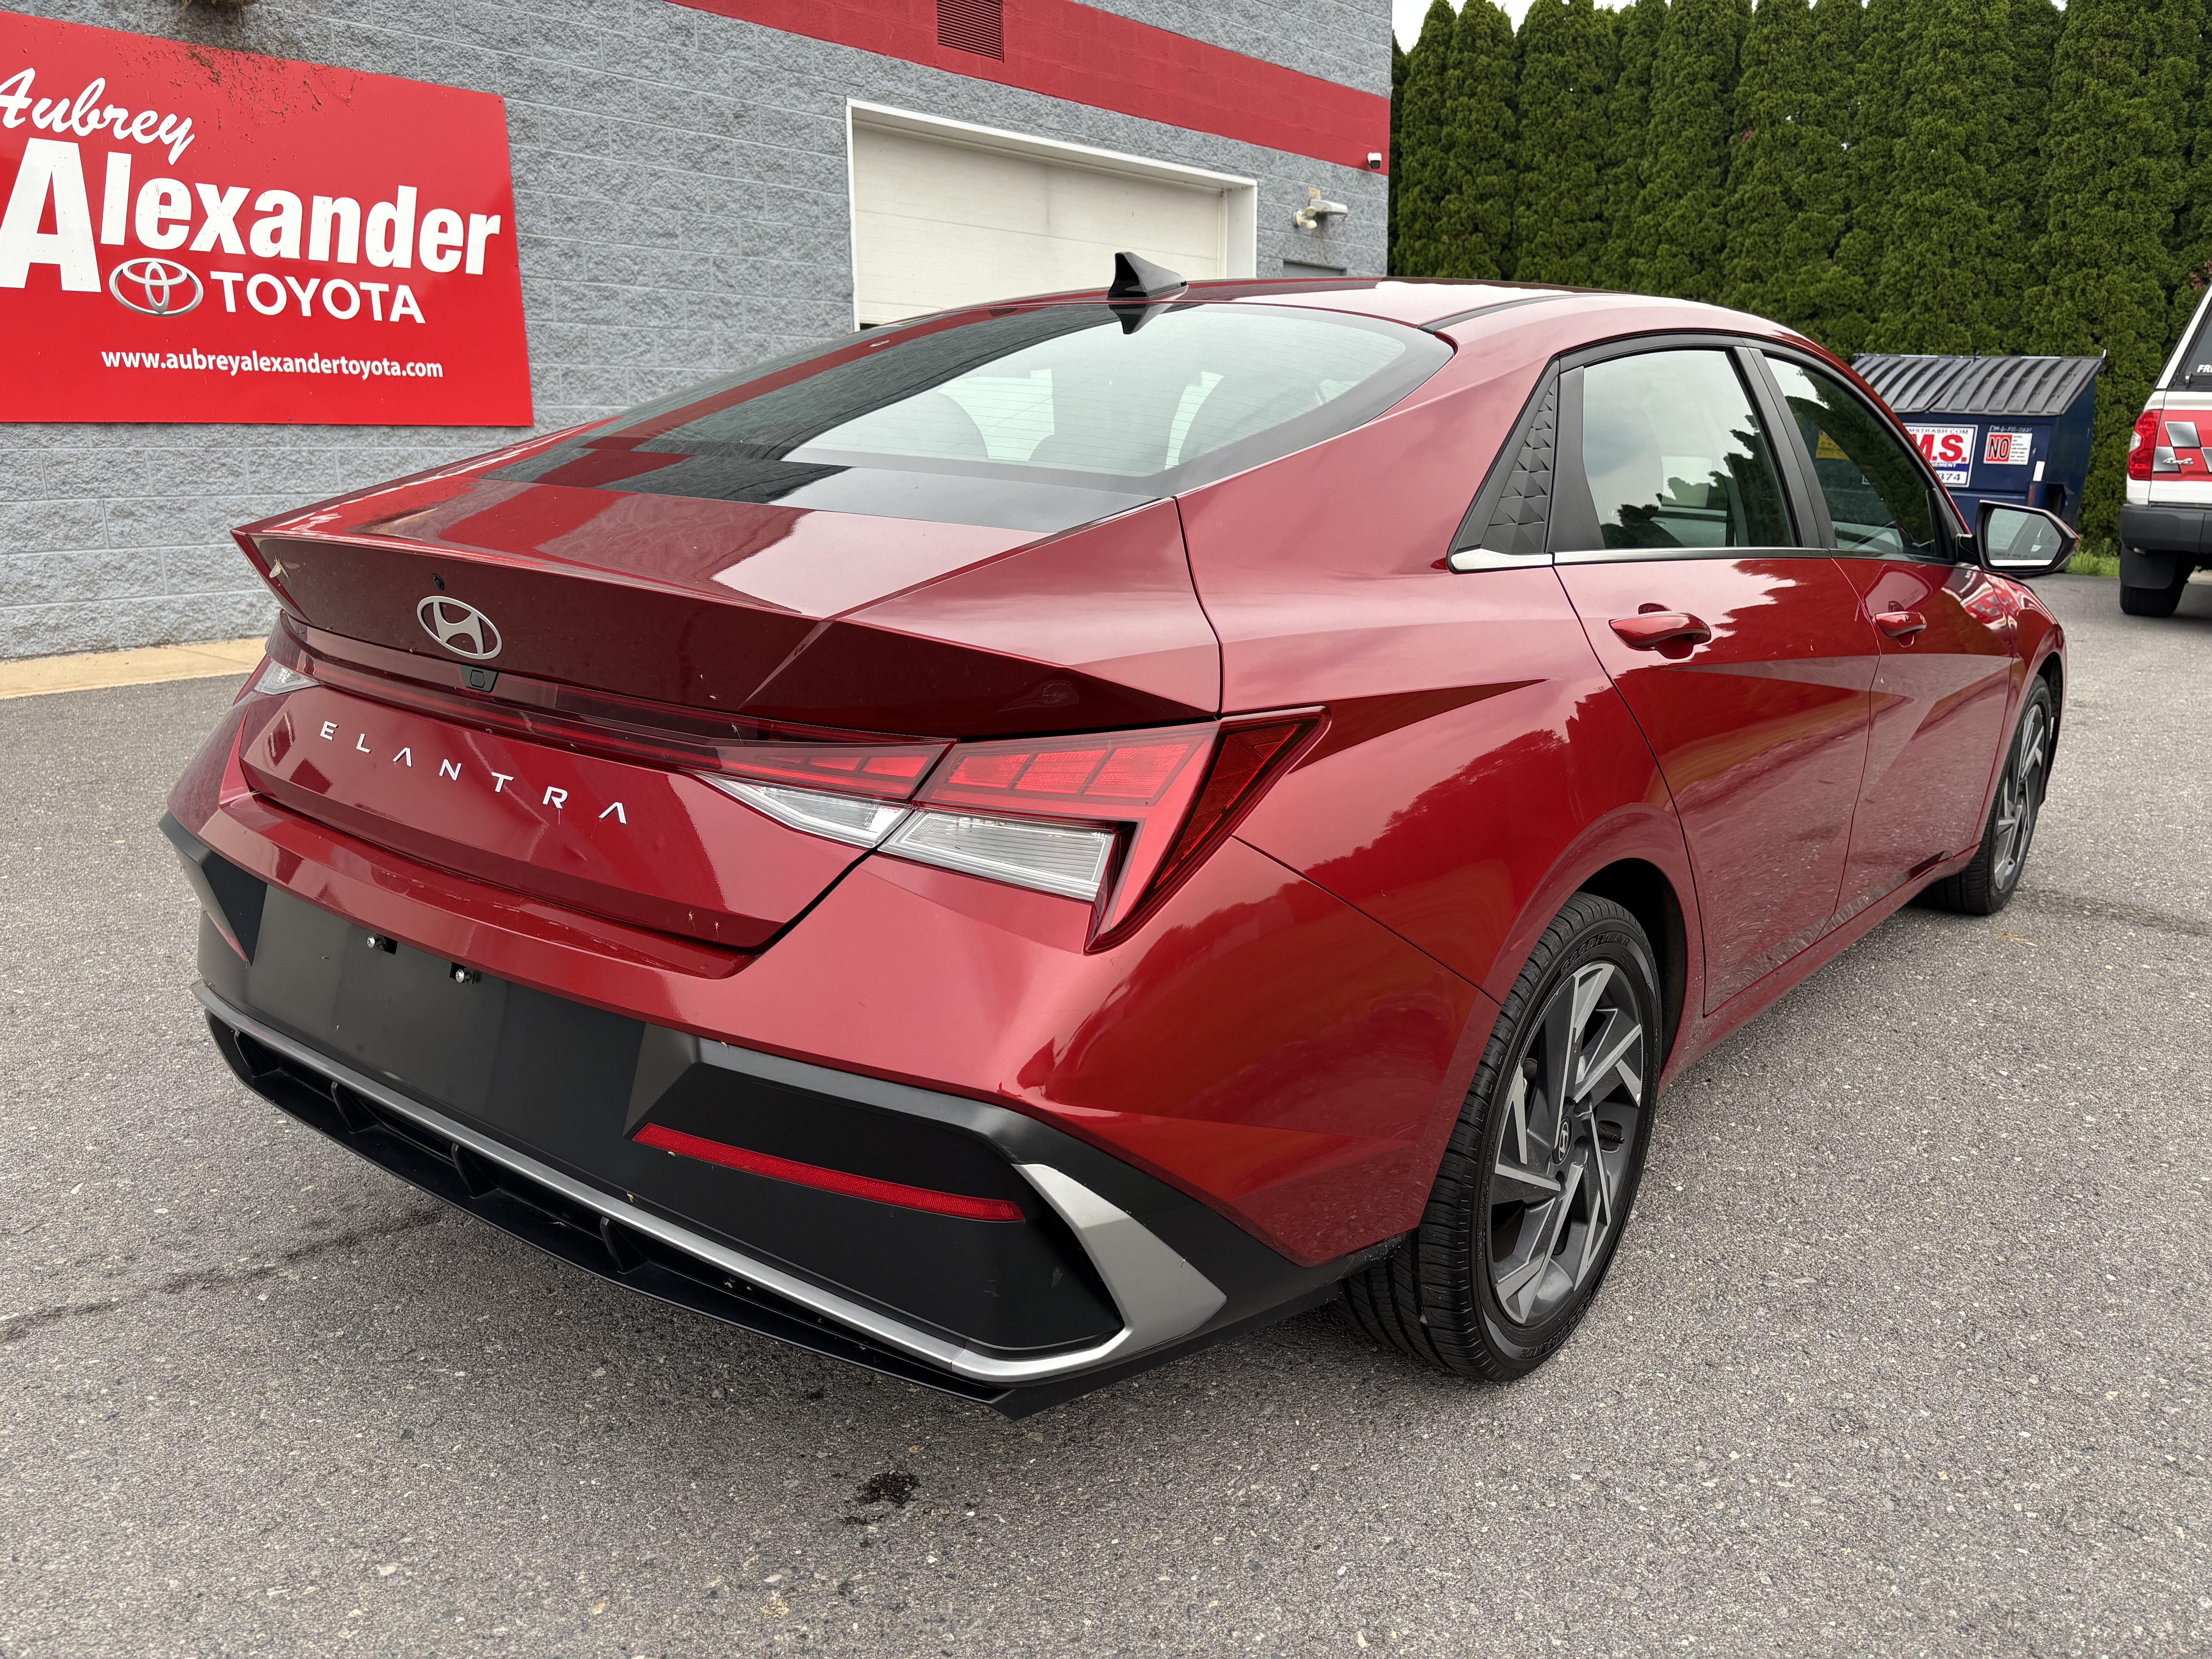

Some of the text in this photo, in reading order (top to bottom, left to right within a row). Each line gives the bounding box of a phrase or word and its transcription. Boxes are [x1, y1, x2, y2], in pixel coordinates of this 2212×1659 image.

[0, 67, 195, 165] Aubrey
[0, 137, 501, 293] Alexander
[210, 271, 426, 324] TOYOTA
[101, 348, 443, 380] www.aubreyalexandertoyota.com
[1988, 437, 2009, 459] NO
[320, 721, 627, 824] ELANTRA
[1561, 933, 1631, 975] GOODYEAR
